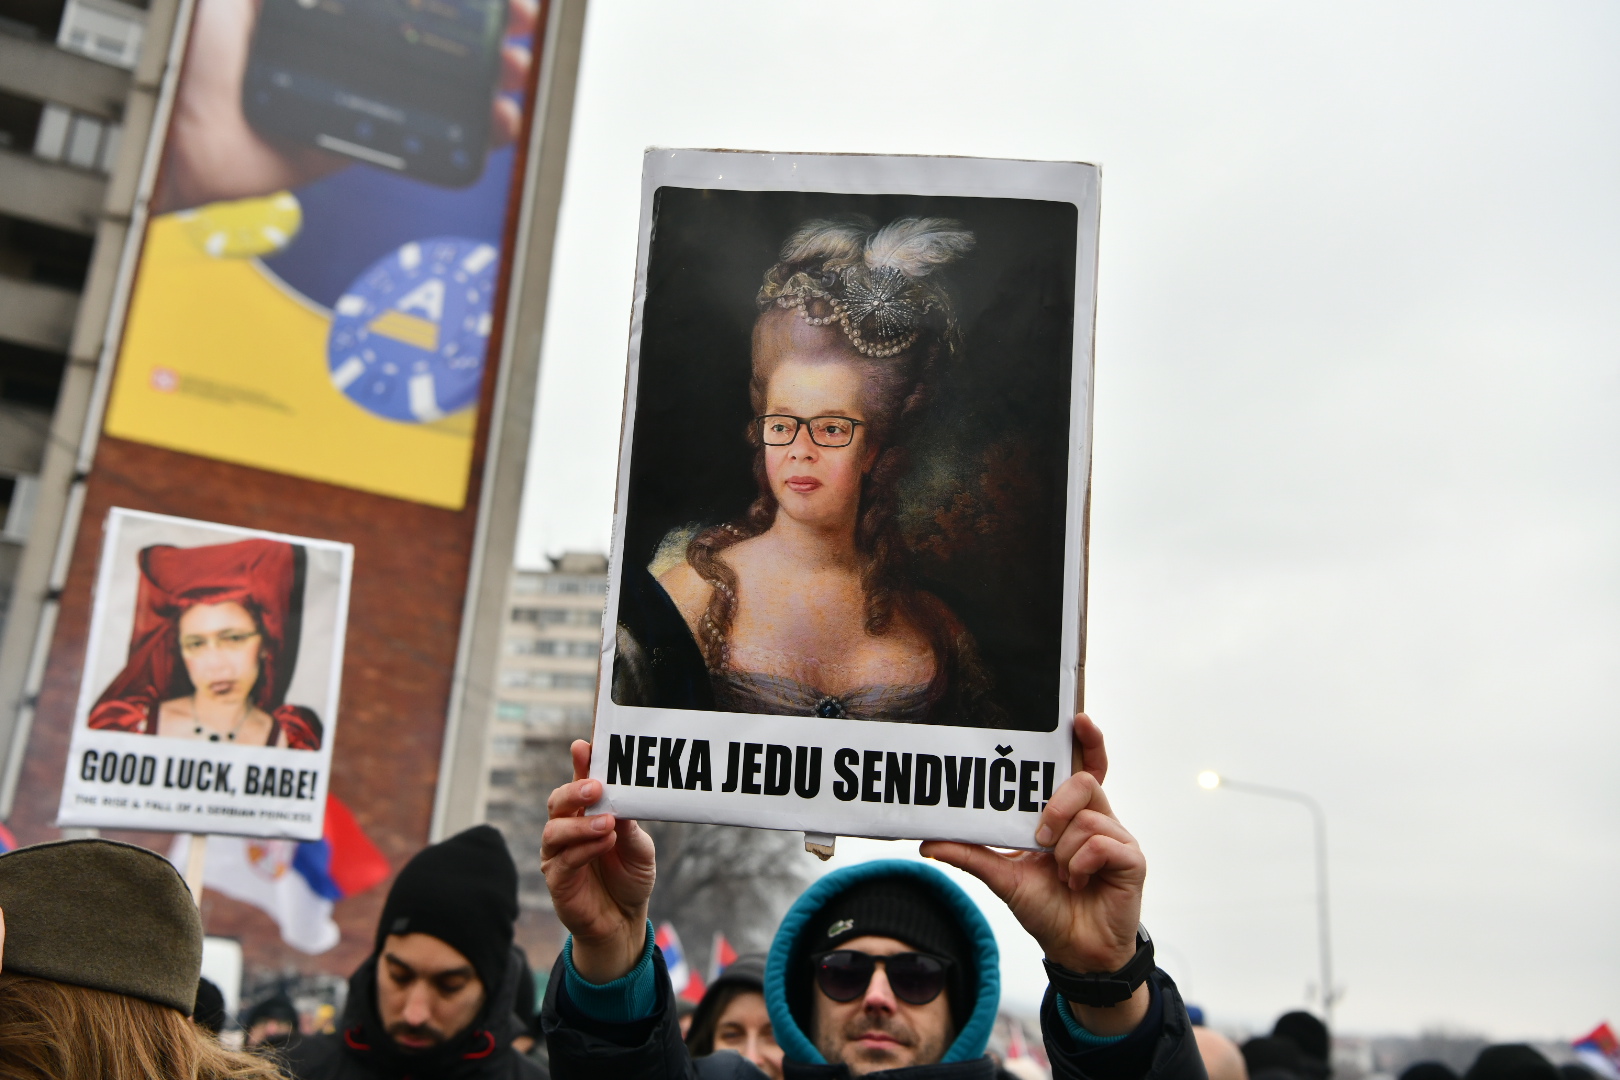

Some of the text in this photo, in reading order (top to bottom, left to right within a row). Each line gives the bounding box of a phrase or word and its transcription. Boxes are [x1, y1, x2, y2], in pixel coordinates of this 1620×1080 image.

[80, 750, 318, 800] GOOD LUCK, BABE!
[606, 734, 1056, 813] NEKA JEDU SENDVIČE!
[75, 795, 313, 823] THE RISE & FALL OF A SERBIAN PRINCESS
